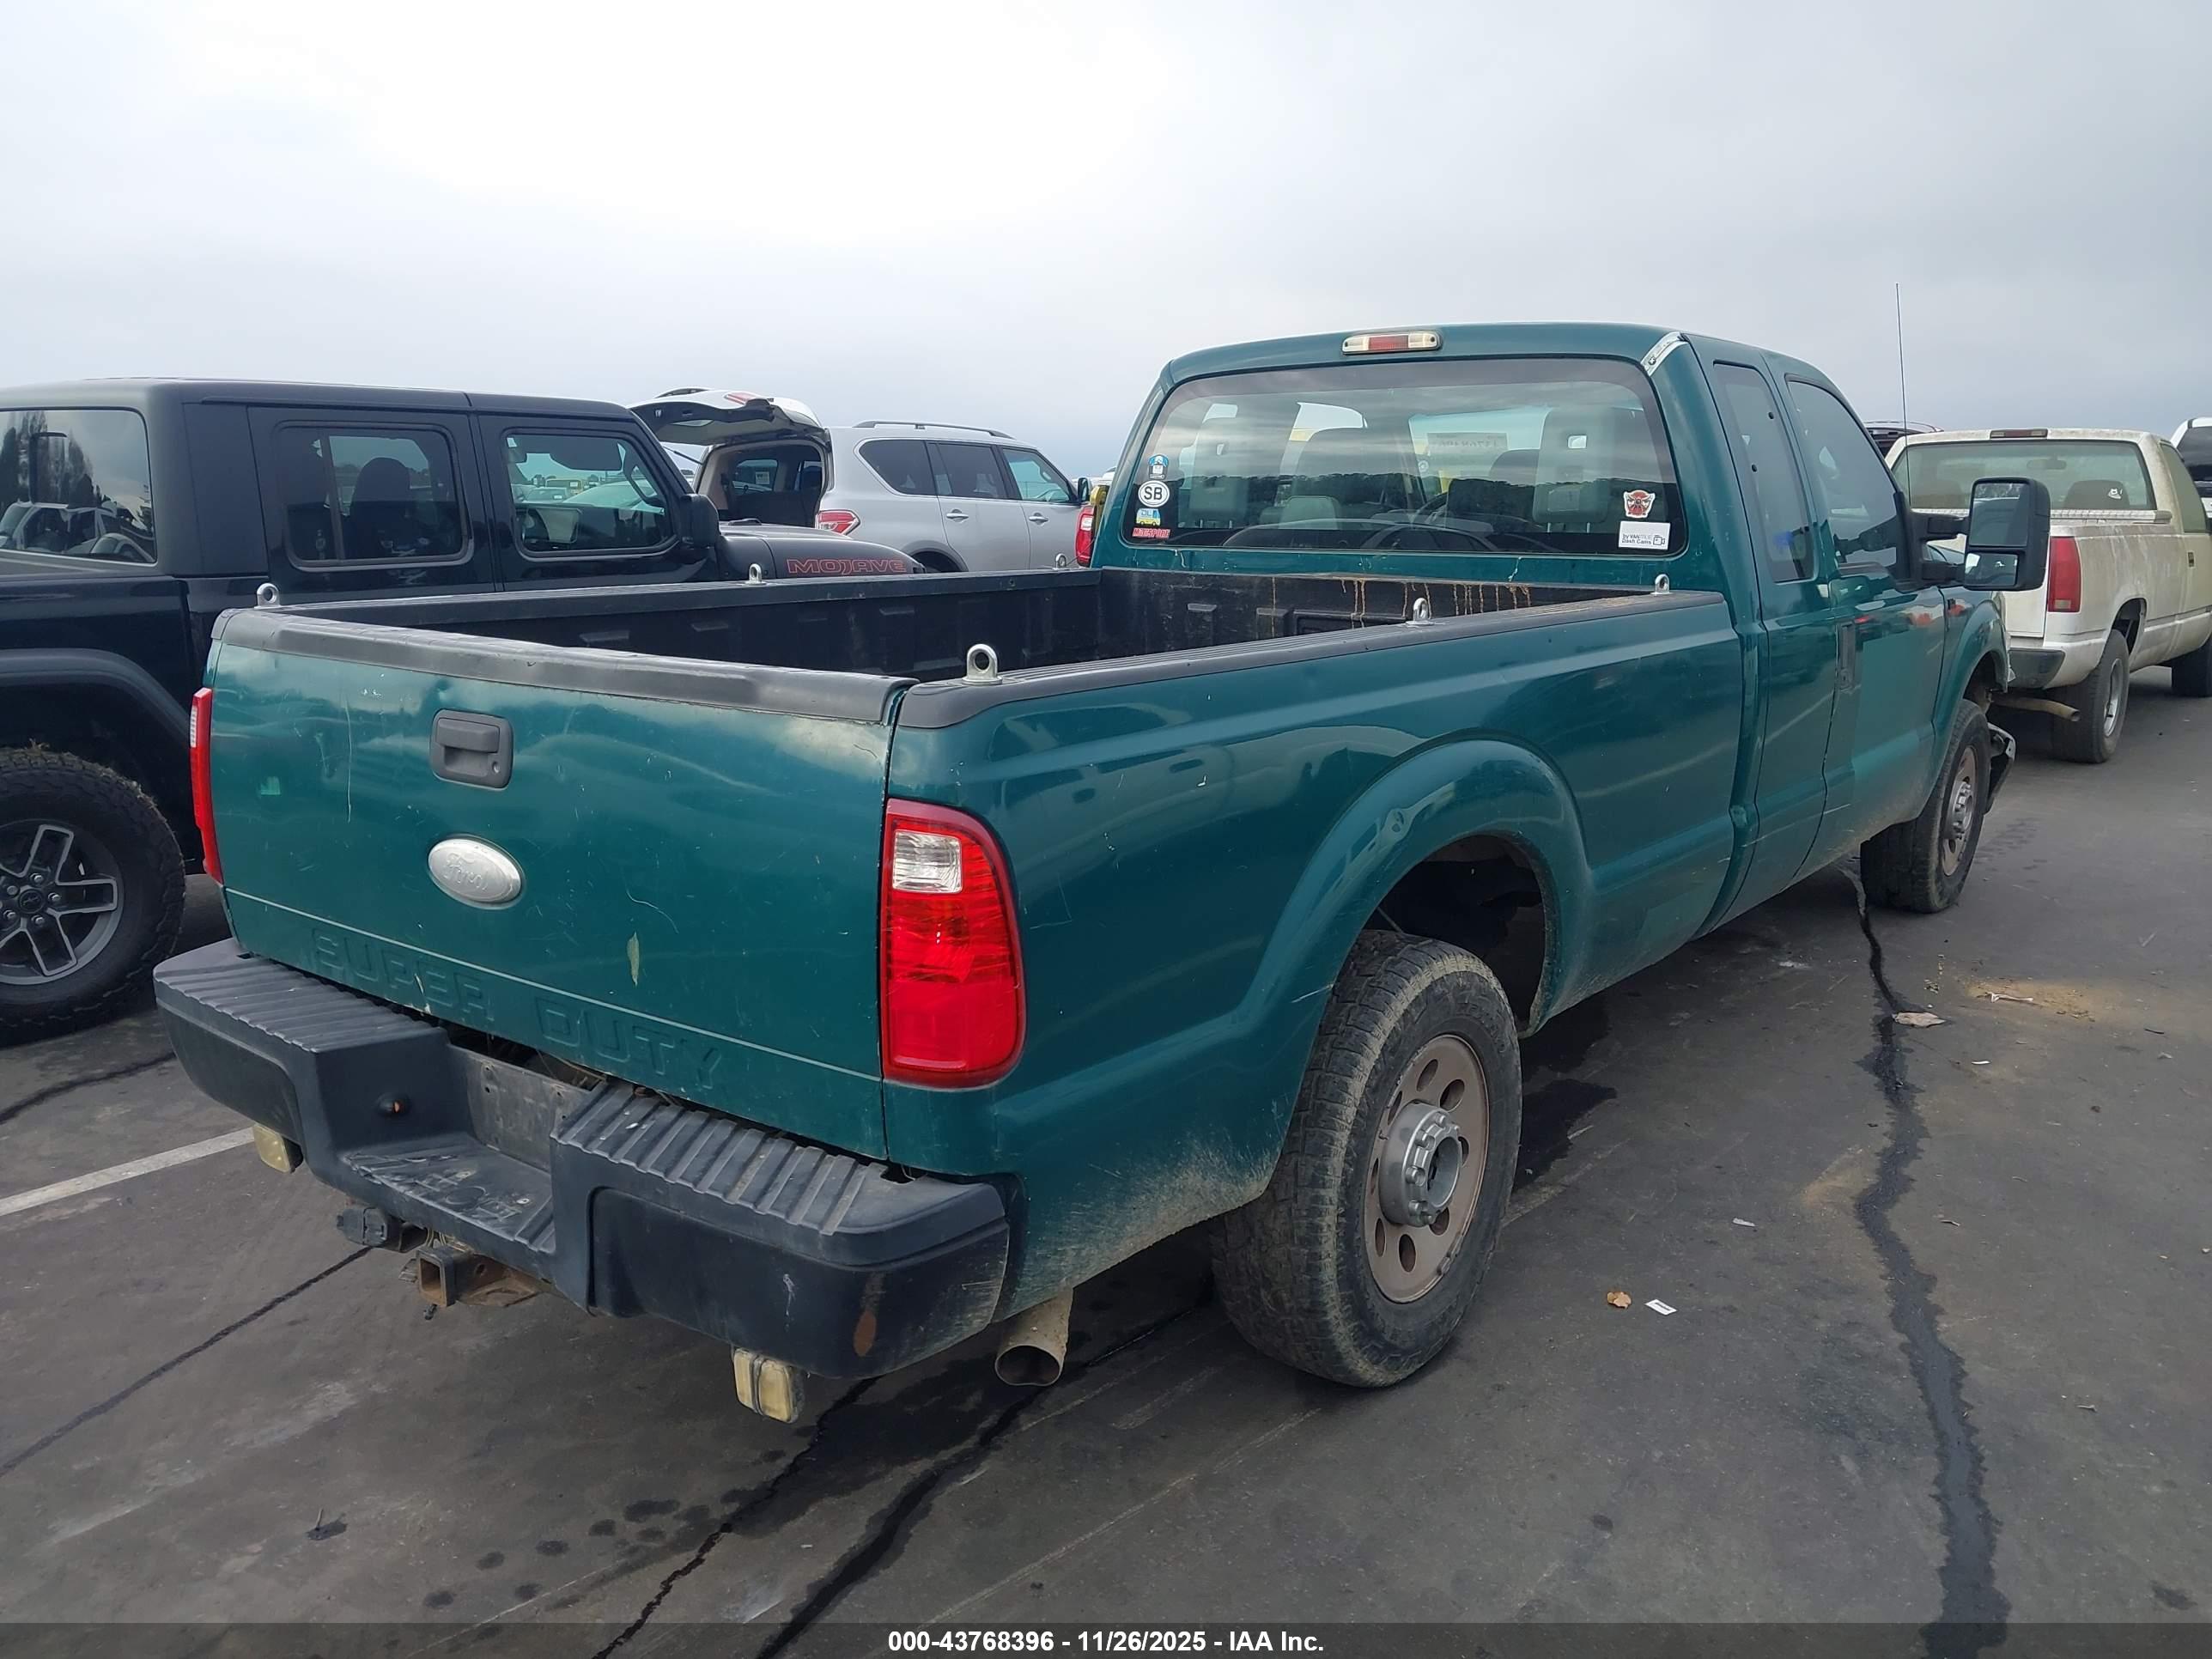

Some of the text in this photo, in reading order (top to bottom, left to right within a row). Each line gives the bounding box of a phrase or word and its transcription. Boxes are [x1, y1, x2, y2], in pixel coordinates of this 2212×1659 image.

[1144, 486, 1163, 500] SB
[787, 558, 908, 574] MOJAVE
[312, 927, 723, 1091] SUPER DUTY
